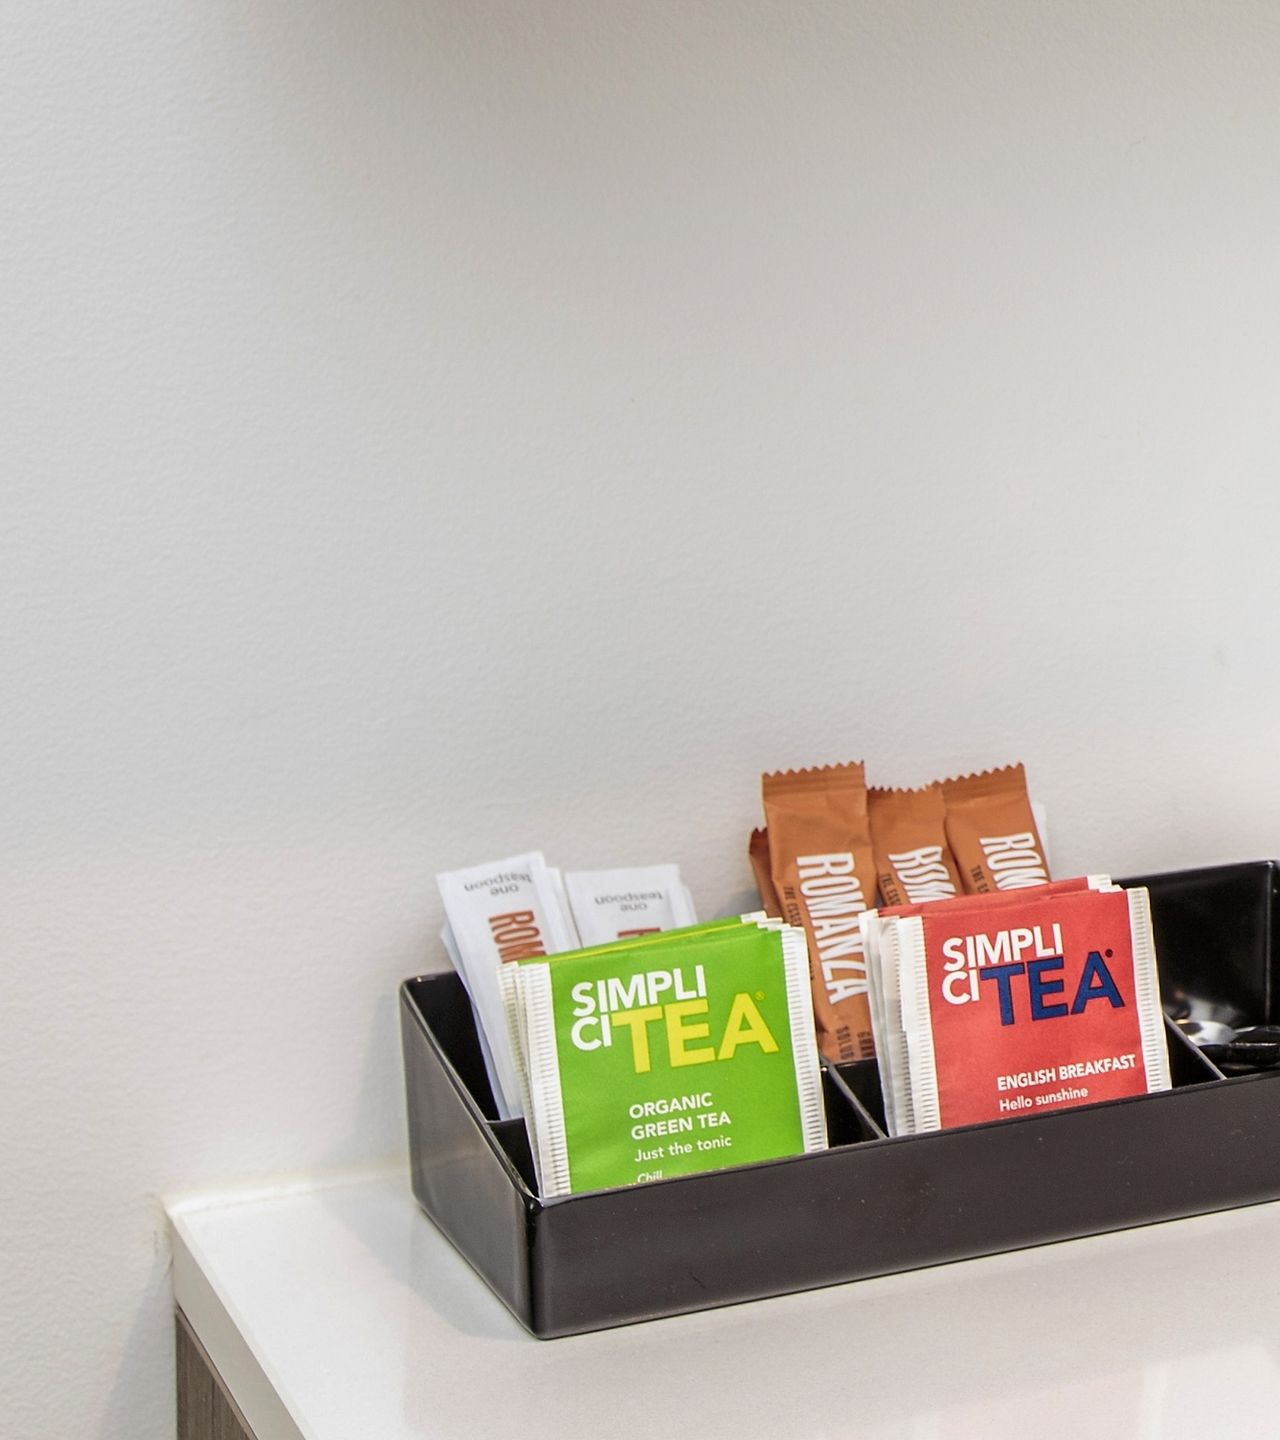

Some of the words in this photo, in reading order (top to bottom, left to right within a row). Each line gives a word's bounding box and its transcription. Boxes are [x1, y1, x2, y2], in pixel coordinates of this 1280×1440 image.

[464, 872, 534, 893] teaspoon
[490, 884, 519, 896] one
[595, 892, 664, 906] teaspoon
[620, 902, 648, 912] one
[796, 852, 869, 1006] ROMANZA
[943, 923, 1064, 973] SIMPLI
[571, 964, 707, 1018] SIMPLI
[997, 1067, 1057, 1092] ENGLISH
[1059, 1054, 1137, 1079] BREAKFAST
[628, 1092, 713, 1119] ORGANIC
[999, 1096, 1033, 1112] Hello
[1035, 1086, 1089, 1106] sunshine
[630, 1116, 693, 1140] GREEN
[697, 1111, 732, 1129] TEA
[634, 1147, 665, 1163] Just
[668, 1140, 693, 1157] the
[697, 1135, 733, 1152] tonic
[637, 1170, 664, 1184] Chill
